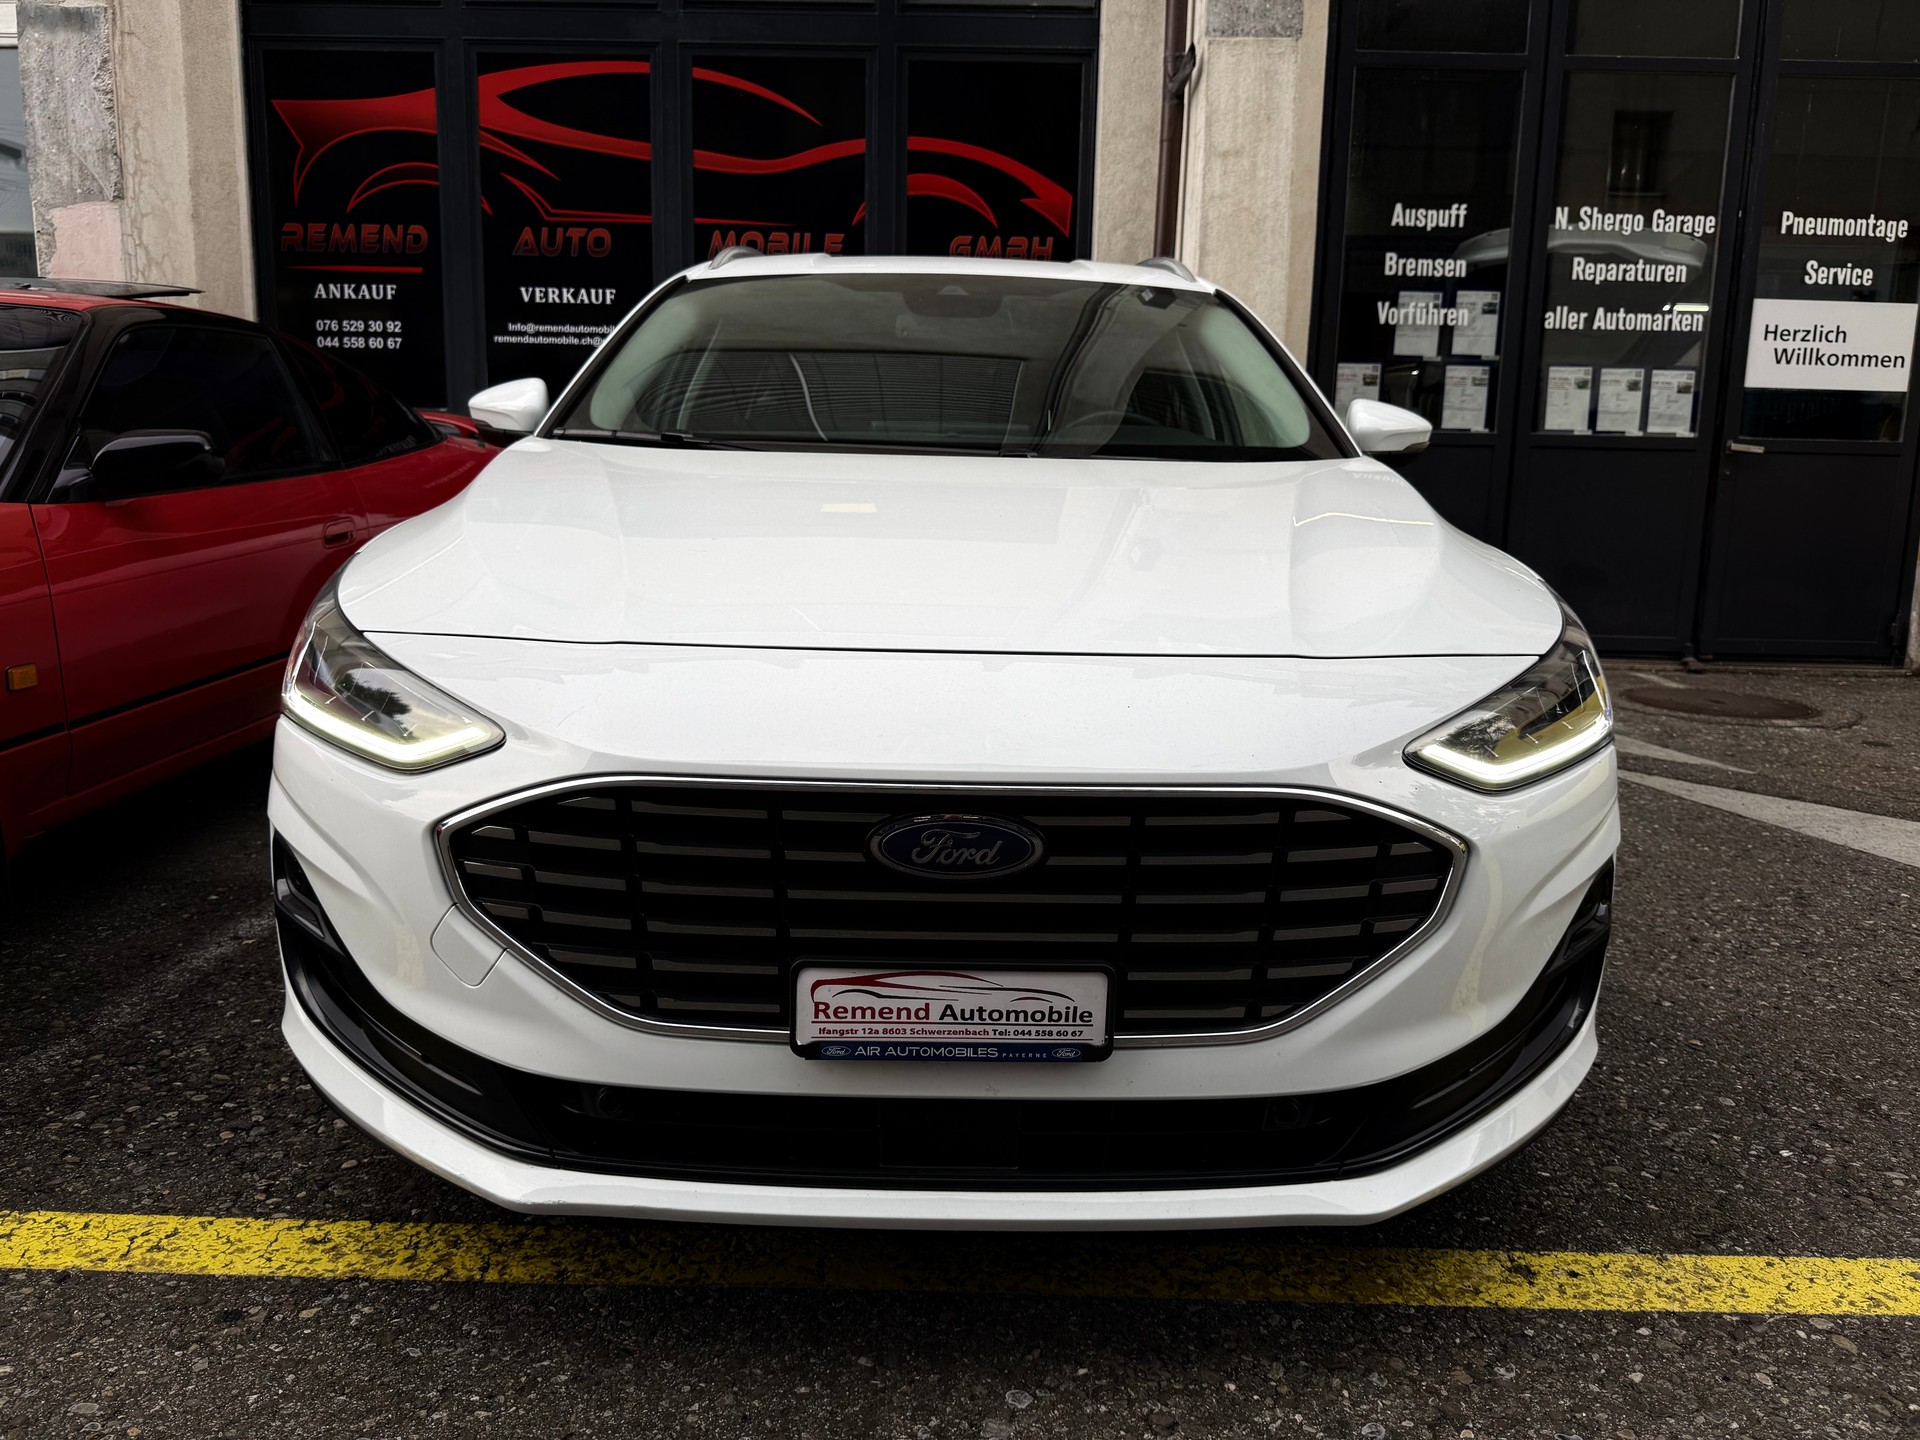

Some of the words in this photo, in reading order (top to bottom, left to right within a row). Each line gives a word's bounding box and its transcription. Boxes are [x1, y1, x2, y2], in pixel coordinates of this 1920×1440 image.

[1391, 202, 1468, 231] Auspuff
[1554, 206, 1573, 230] N.
[1578, 206, 1644, 235] Shergo
[1652, 208, 1716, 237] Garage
[1780, 210, 1909, 243] Pneumontage
[280, 222, 429, 254] REMEND
[512, 226, 612, 258] AUTO
[709, 229, 845, 257] MOBILE
[1384, 251, 1467, 278] Bremsen
[1571, 257, 1687, 285] Reparaturen
[1804, 259, 1874, 286] Service
[314, 283, 397, 300] ANKAUF
[519, 286, 616, 304] VERKAUF
[316, 319, 339, 332] 076
[342, 320, 365, 332] 529
[368, 320, 383, 332] 30
[386, 321, 402, 332] 92
[1377, 301, 1469, 327] Vorführen
[1544, 305, 1588, 330] aller
[1592, 307, 1704, 332] Automarken
[507, 322, 617, 335] Info@remendautomobil
[1763, 324, 1847, 344] Herzlich
[317, 336, 340, 348] 044
[342, 337, 365, 348] 558
[368, 337, 384, 349] 60
[387, 338, 403, 349] 67
[1773, 347, 1906, 369] Willkommen
[911, 828, 1003, 866] Ford
[813, 1002, 930, 1021] Remend
[938, 1003, 1093, 1024] Automobile
[818, 1027, 859, 1037] Ifangstr
[861, 1027, 879, 1035] 12a
[882, 1027, 907, 1035] 8603
[909, 1028, 989, 1037] Schwerzenbach
[992, 1029, 1011, 1037] Tel:
[1013, 1029, 1032, 1037] 044
[855, 1046, 880, 1056] AIR
[885, 1046, 998, 1058] AUTOMOBILES
